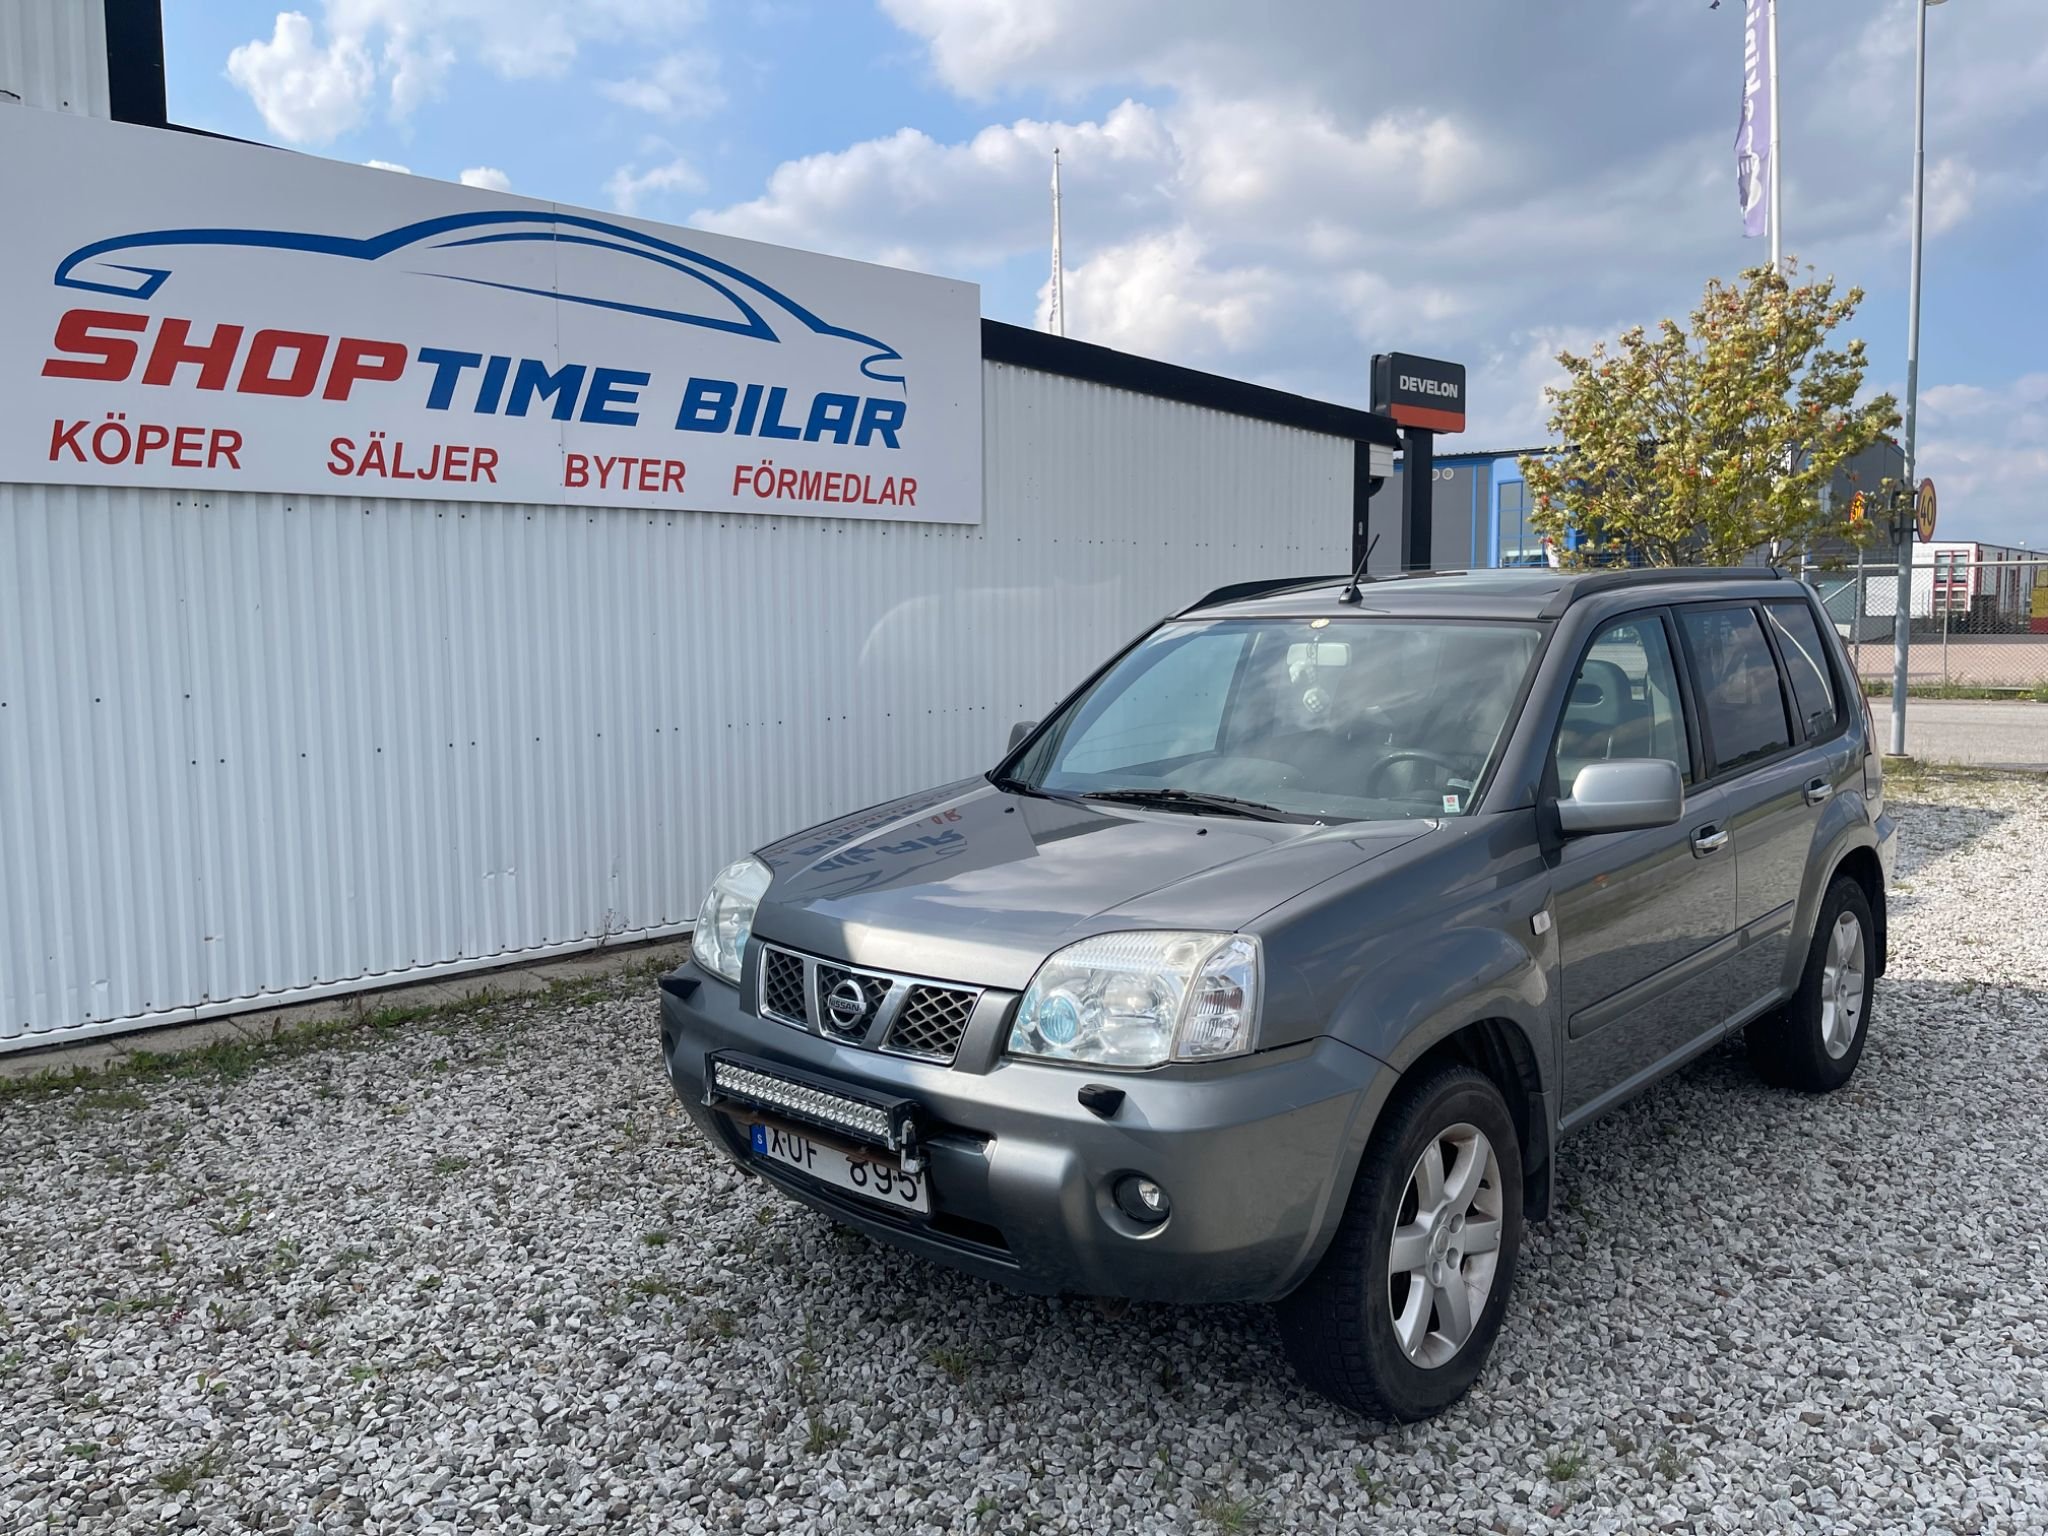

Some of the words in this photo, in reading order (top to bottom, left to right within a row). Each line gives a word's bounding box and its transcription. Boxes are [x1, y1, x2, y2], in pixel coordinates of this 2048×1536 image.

[1400, 375, 1458, 398] DEVELON
[675, 377, 907, 449] BILAR
[49, 412, 243, 469] KÖPER
[327, 431, 498, 483] SÄLJER
[564, 454, 686, 493] BYTER
[733, 459, 917, 506] FÖRMEDLAR
[1920, 495, 1934, 526] 40
[830, 999, 861, 1012] NISSAN
[757, 1133, 763, 1145] S
